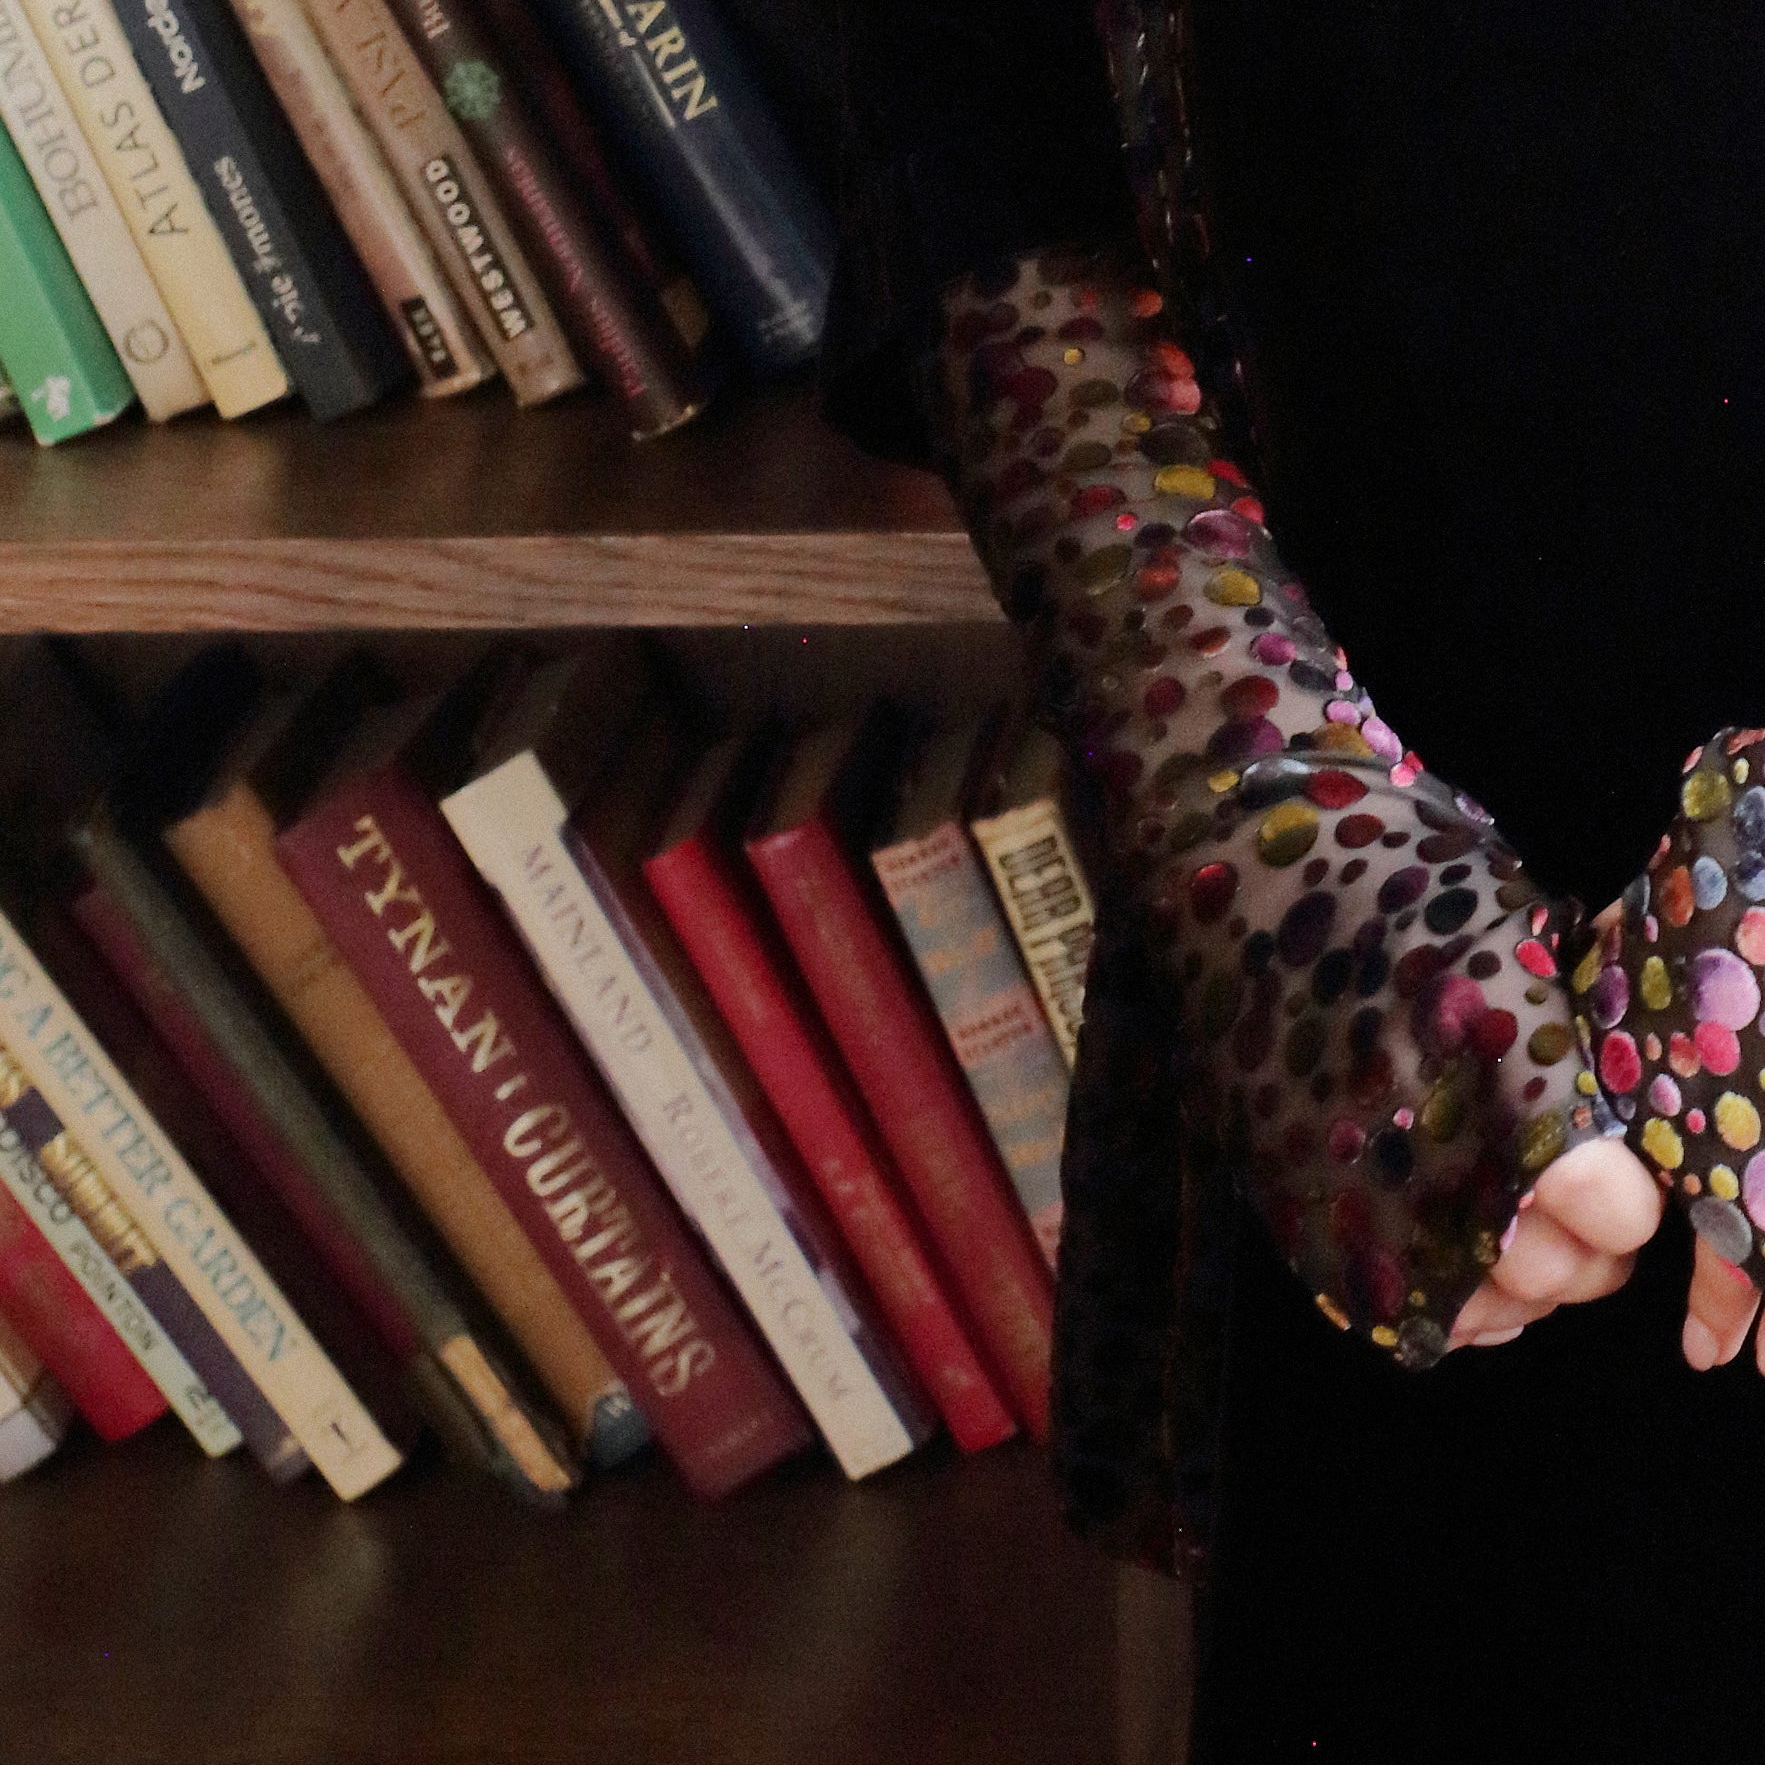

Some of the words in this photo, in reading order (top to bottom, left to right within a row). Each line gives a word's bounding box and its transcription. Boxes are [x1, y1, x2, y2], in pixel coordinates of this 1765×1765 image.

[0, 28, 101, 222] BOHUM
[90, 96, 191, 250] ATLAS
[422, 156, 528, 339] WESTWOOD
[325, 814, 520, 1080] TYNAN
[494, 1091, 723, 1400] CURTAINS
[512, 840, 660, 1059] MAINLAND
[659, 1090, 759, 1229] ROBERT
[16, 1003, 52, 1040] A
[37, 1029, 175, 1196] BETTER
[158, 1190, 300, 1364] GARDEN
